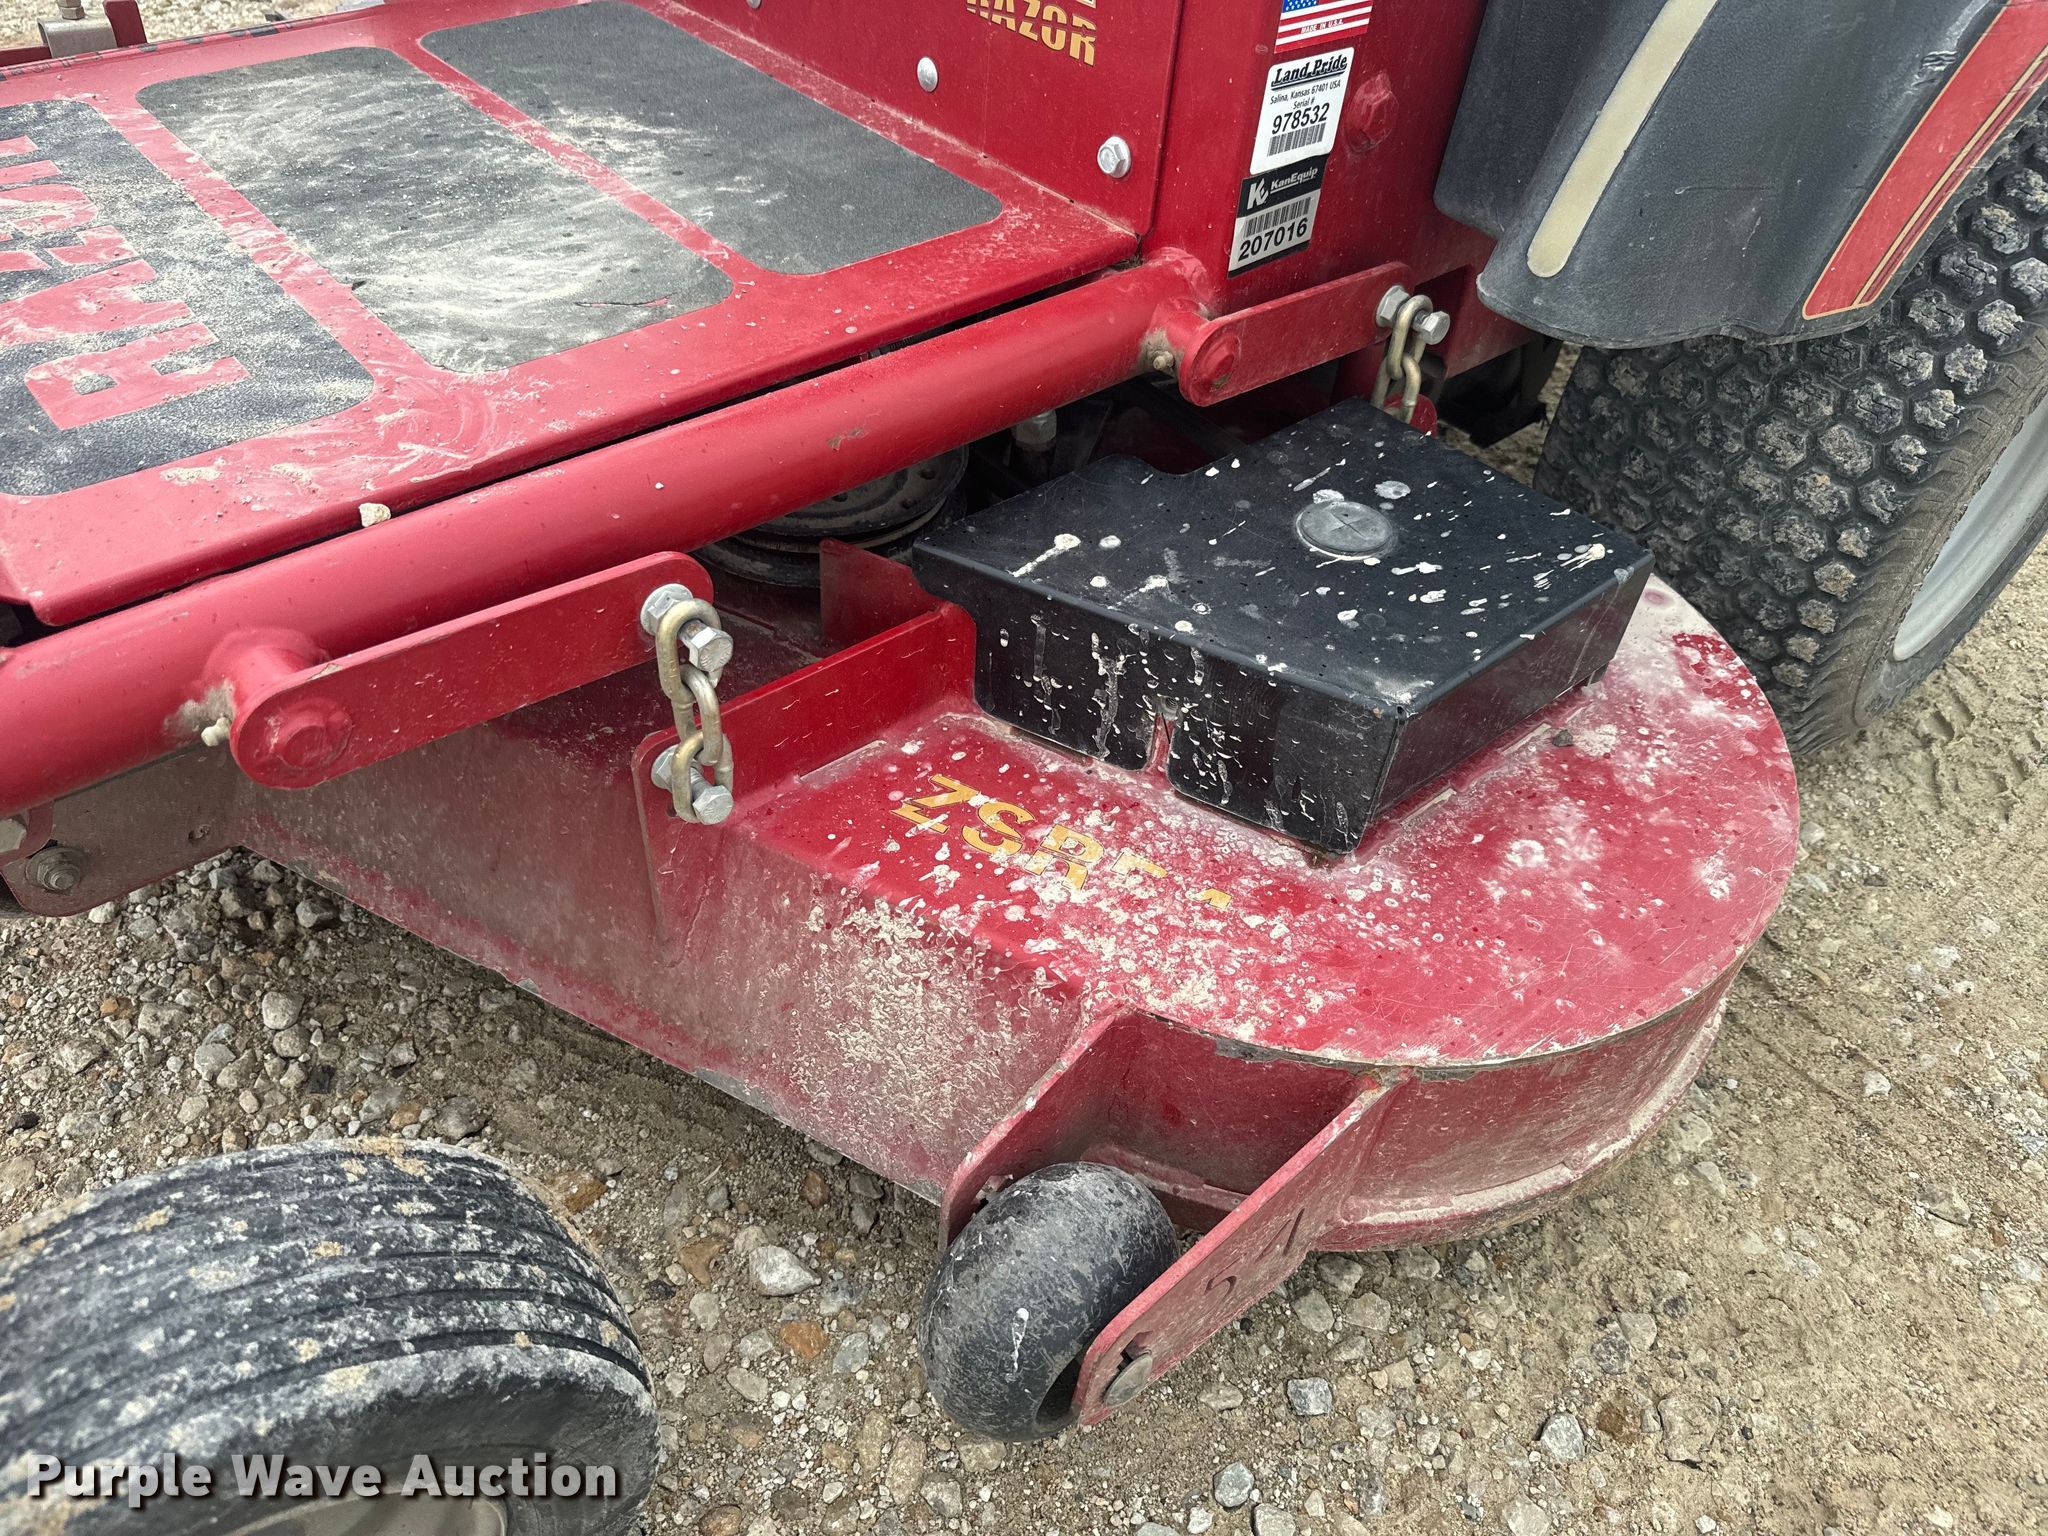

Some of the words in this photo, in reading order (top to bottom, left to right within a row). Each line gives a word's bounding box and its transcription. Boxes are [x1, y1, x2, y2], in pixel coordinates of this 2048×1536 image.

[966, 0, 1097, 66] AZOR
[1300, 25, 1318, 34] MADE
[1319, 22, 1327, 30] IN
[1328, 19, 1344, 28] U.S.A.
[1271, 61, 1310, 87] Land
[1310, 54, 1348, 77] Pride
[1270, 94, 1289, 105] Salina,
[1290, 88, 1310, 100] Kansas
[1311, 82, 1328, 95] 67401
[1329, 79, 1341, 90] USA
[1293, 97, 1309, 110] Serial
[1272, 102, 1330, 135] 978532
[1270, 166, 1319, 191] KanEquip
[1238, 217, 1309, 262] 207016
[0, 135, 251, 431] RAZ
